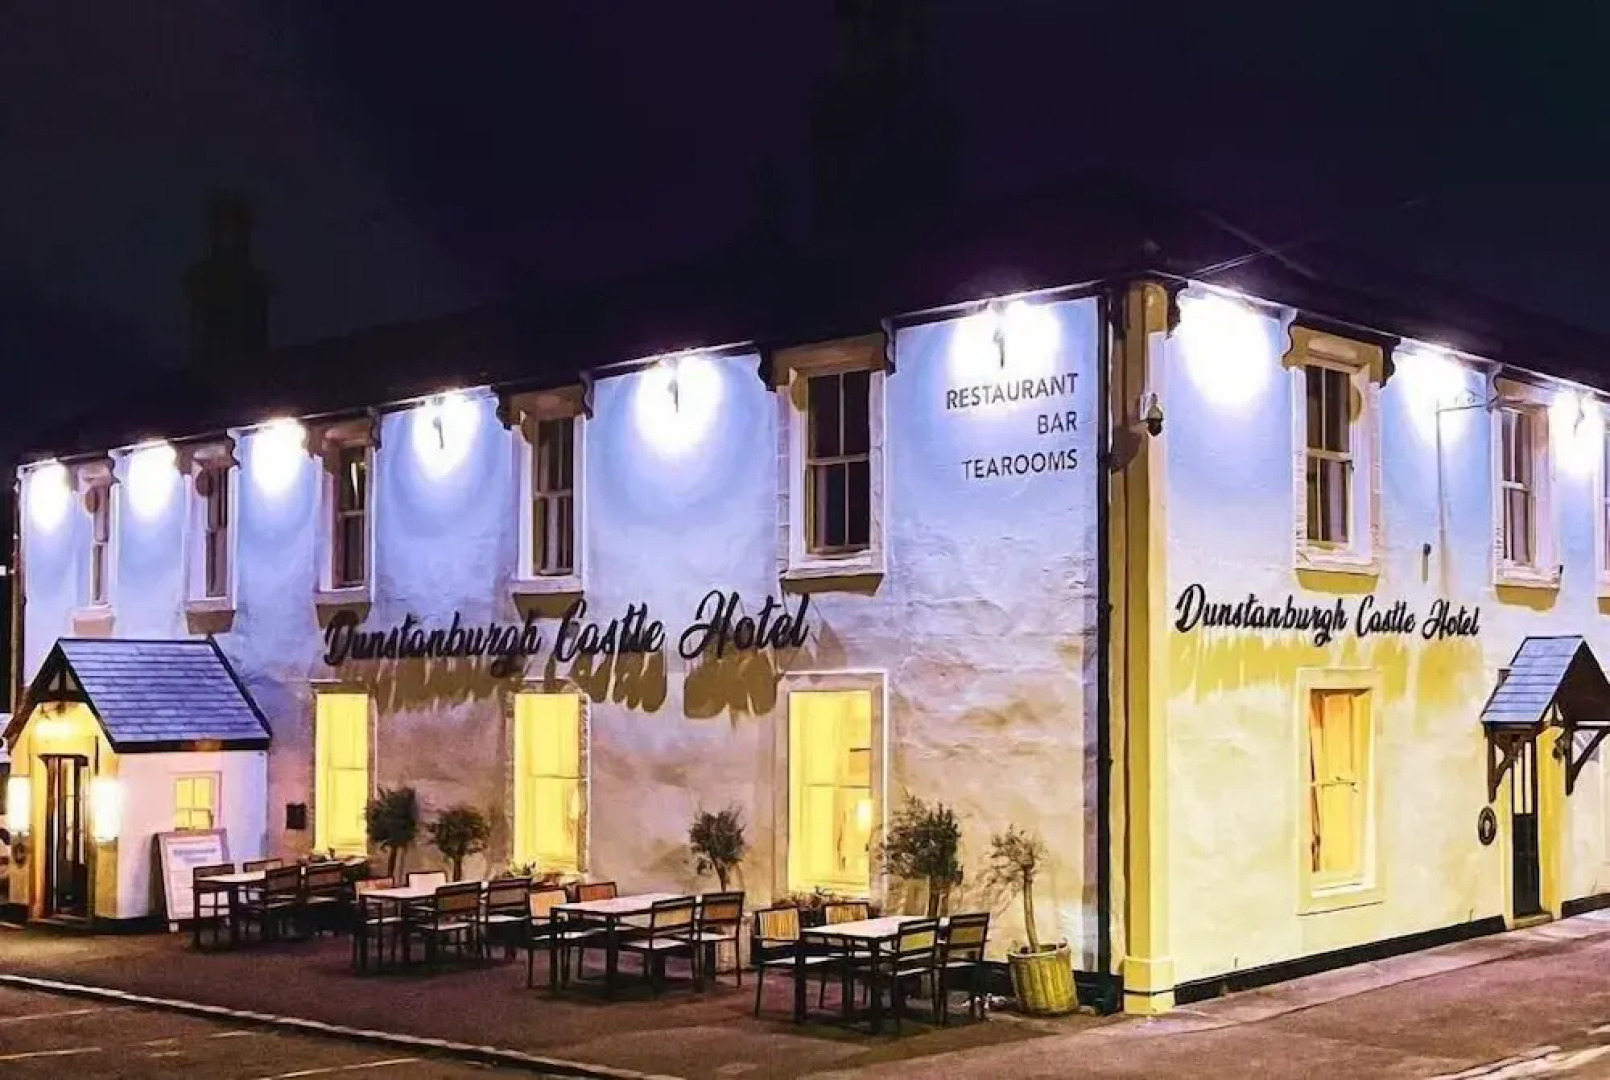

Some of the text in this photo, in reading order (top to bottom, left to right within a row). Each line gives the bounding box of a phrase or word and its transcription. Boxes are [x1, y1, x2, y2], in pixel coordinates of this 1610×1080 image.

[946, 373, 1079, 410] RESTAURANT
[1037, 411, 1078, 435] BAR
[961, 449, 1078, 480] TEAROOMS
[324, 590, 811, 677] Dunstanburgh Castle Hotel
[1174, 583, 1480, 647] Dunstanburgh Castle Hotel
